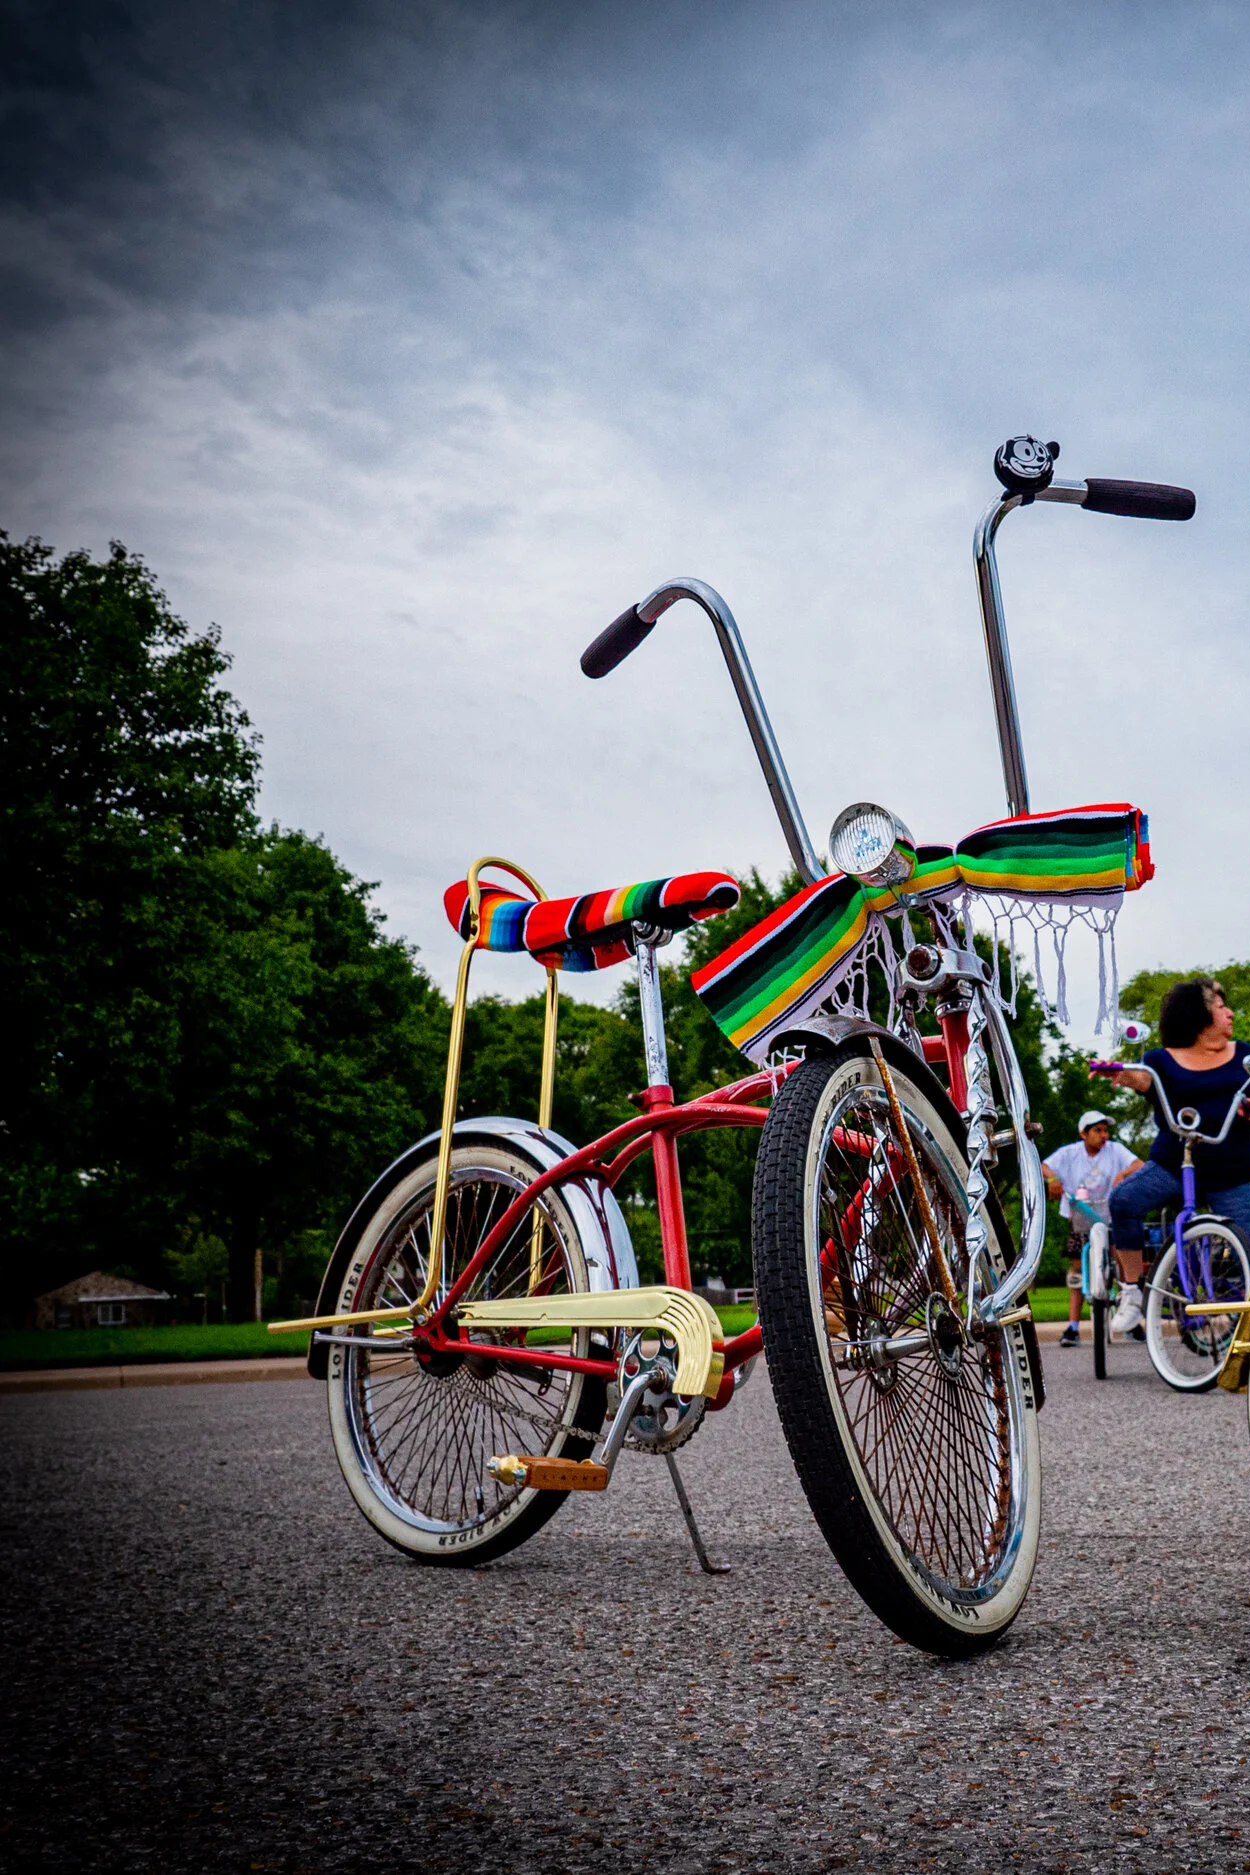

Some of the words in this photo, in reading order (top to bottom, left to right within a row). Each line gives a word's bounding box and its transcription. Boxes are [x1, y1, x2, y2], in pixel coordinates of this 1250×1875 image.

[341, 1262, 364, 1310] IDER
[1012, 1323, 1034, 1410] RIDER
[438, 1524, 485, 1546] RIDER
